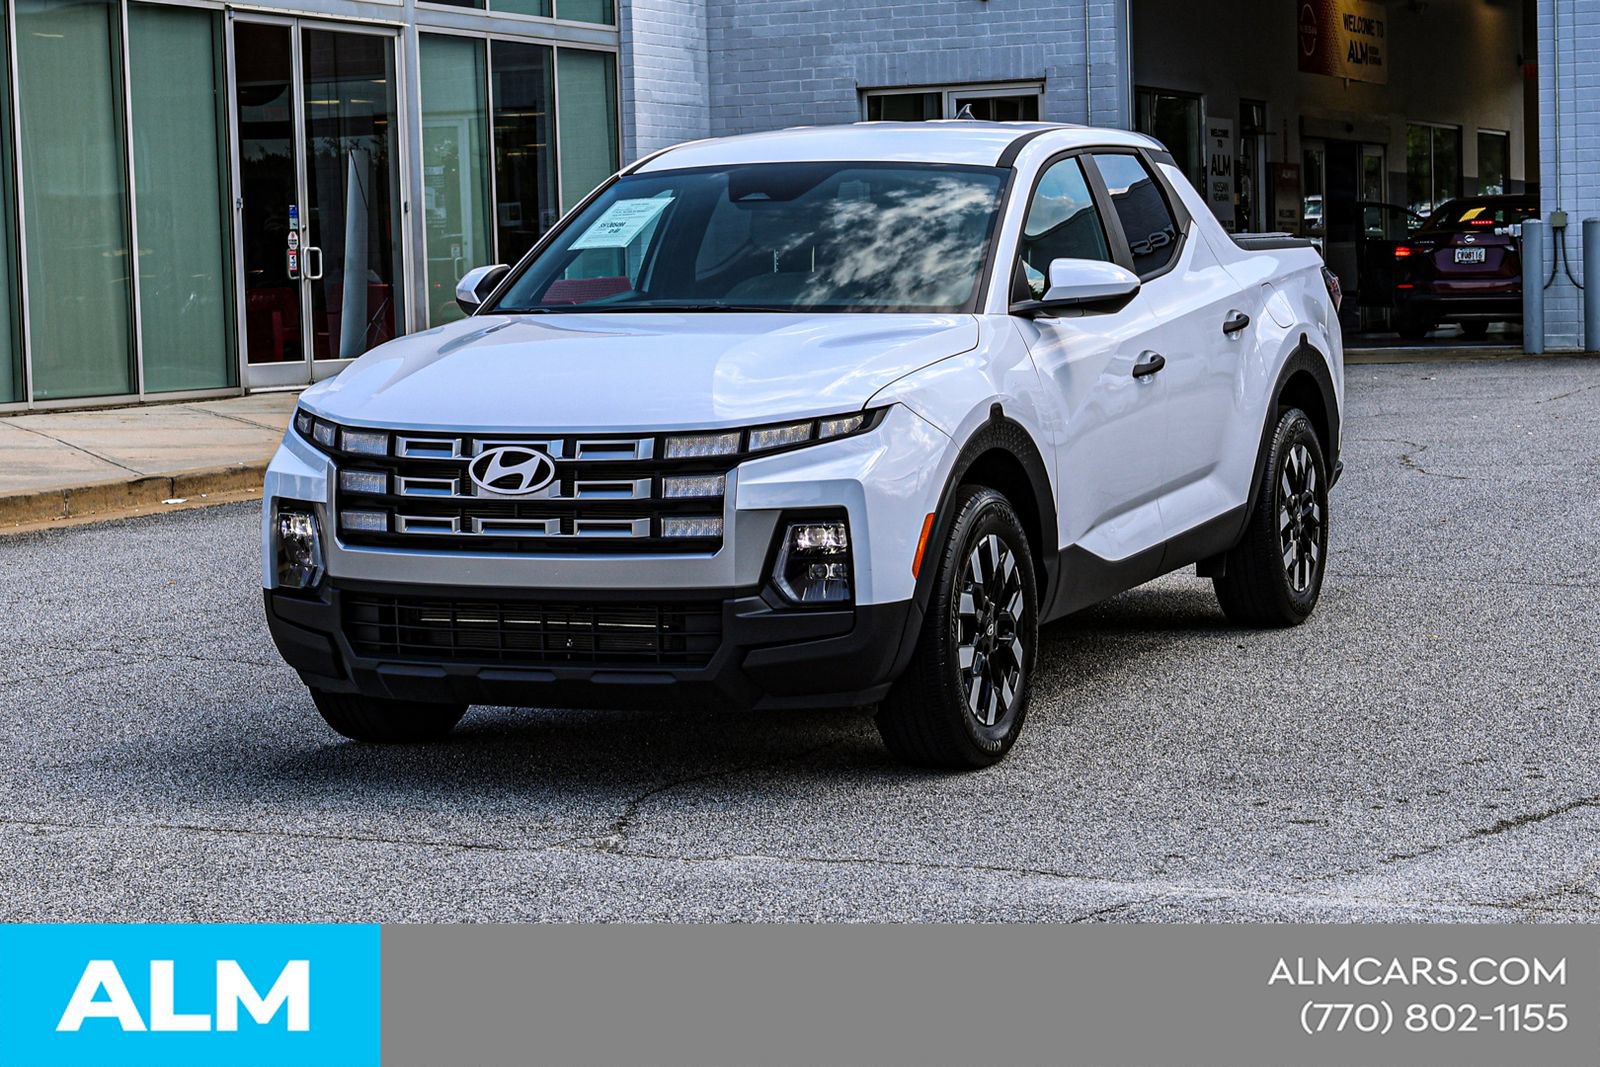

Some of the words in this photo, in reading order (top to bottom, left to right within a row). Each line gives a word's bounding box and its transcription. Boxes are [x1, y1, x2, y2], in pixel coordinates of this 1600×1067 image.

[1343, 13, 1375, 36] WELCOME
[1347, 40, 1368, 65] ALM
[1211, 154, 1231, 176] ALM
